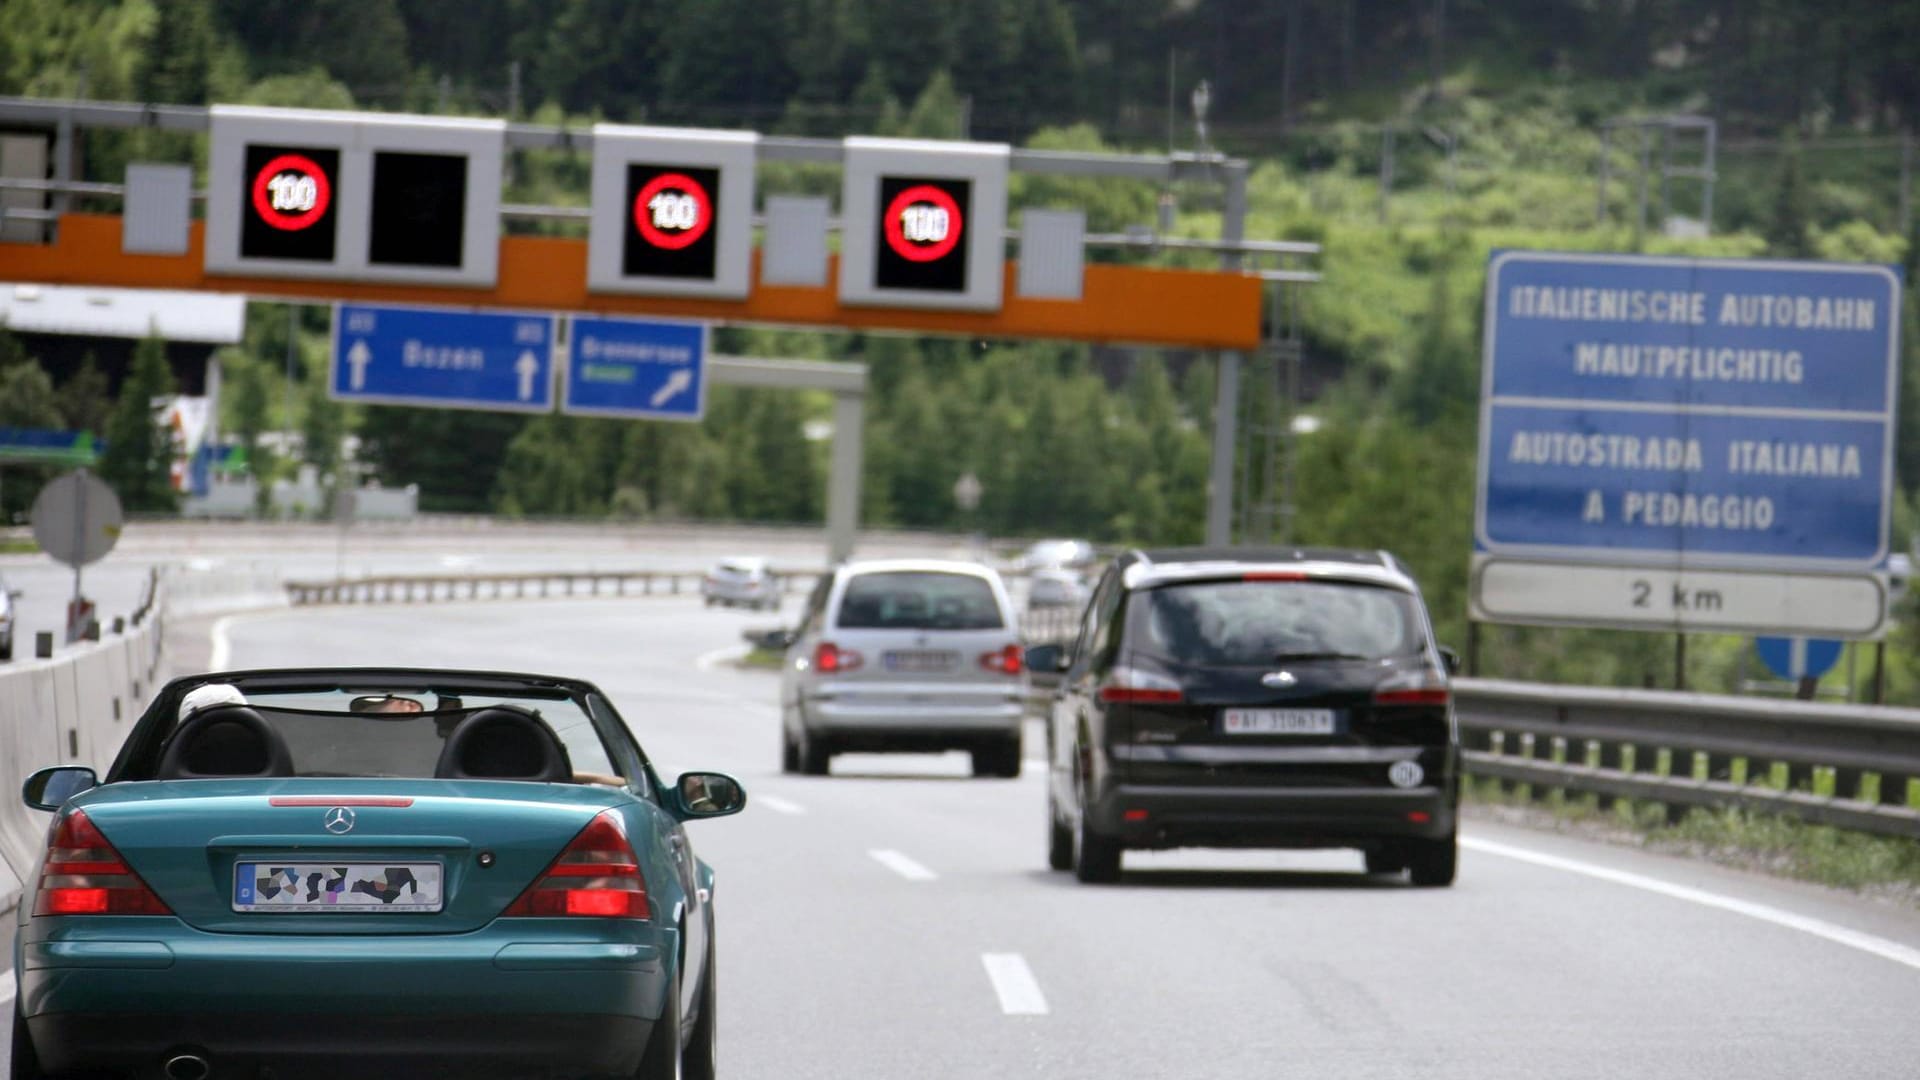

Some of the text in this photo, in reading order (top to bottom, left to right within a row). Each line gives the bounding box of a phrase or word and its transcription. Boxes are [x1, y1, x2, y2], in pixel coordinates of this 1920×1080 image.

[267, 174, 318, 211] 100
[648, 193, 699, 230] 100
[901, 205, 950, 242] 100
[1510, 287, 1876, 331] ITALIENISCHE AUTOBAHN
[402, 340, 484, 370] Bozen
[1574, 343, 1804, 382] MAUTPFLICHTIG
[1511, 432, 1862, 478] AUTOSTRADA ITALIANA
[1582, 491, 1775, 531] A PEDAGGIO
[1631, 582, 1723, 611] 2 km
